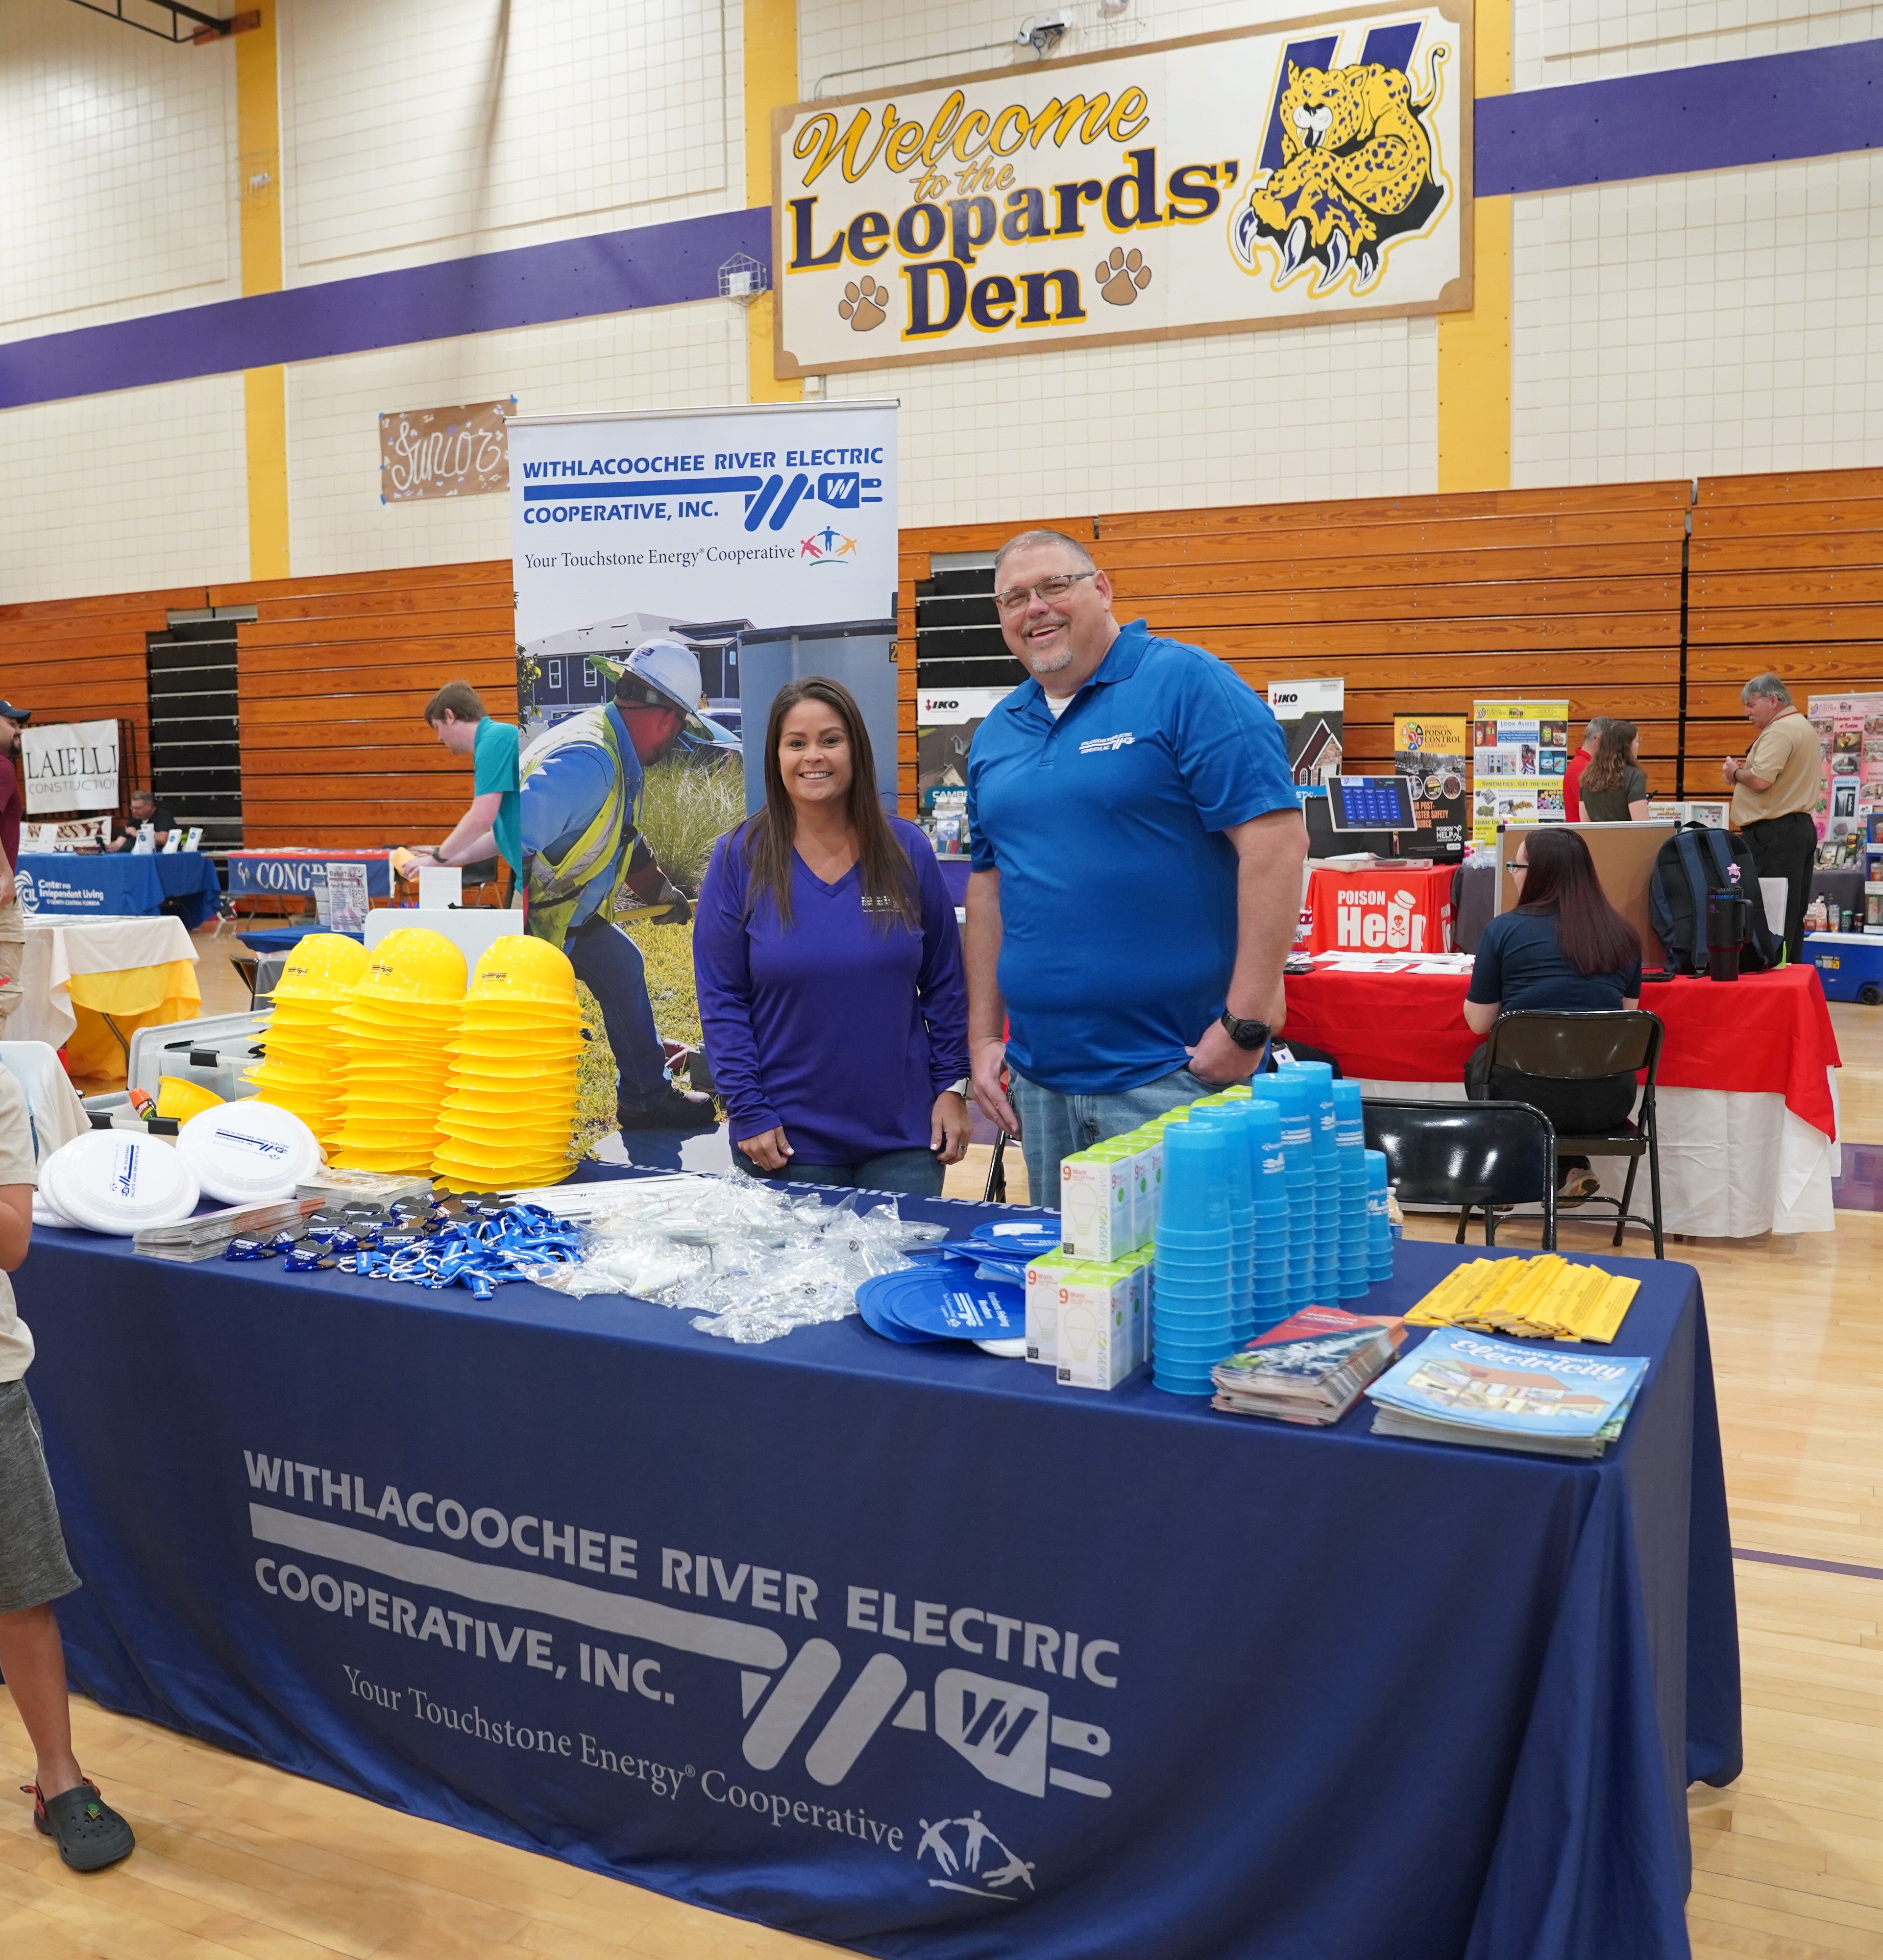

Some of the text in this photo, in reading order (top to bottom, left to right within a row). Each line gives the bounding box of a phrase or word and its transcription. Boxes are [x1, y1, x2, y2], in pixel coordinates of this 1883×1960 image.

[793, 86, 1149, 187] Welcome
[910, 155, 1015, 203] to the
[786, 147, 1240, 274] Leopards'
[899, 260, 1087, 342] Den
[523, 447, 884, 478] WITHLACOOCHEE RIVER ELECTRIC
[523, 500, 718, 524] COOPERATIVE, INC.
[524, 552, 557, 569] Your
[561, 551, 644, 567] Touchstone
[706, 544, 795, 563] Cooperative
[932, 701, 959, 710] IKO
[1278, 694, 1297, 703] IKO
[1421, 801, 1435, 809] POST-
[1431, 810, 1448, 819] SAFETY
[38, 879, 62, 889] Center
[23, 888, 38, 902] CIL
[40, 888, 104, 901] Independent Living
[1338, 890, 1386, 905] POISON
[1063, 1165, 1072, 1180] 9
[1027, 1270, 1036, 1285] 9
[1059, 1288, 1068, 1304] 9
[1449, 1341, 1627, 1381] Electricity
[244, 1449, 1119, 1688] WITHLACOOCHEE RIVER ELECTRIC
[255, 1557, 674, 1705] COOPERATIVE, INC.
[343, 1665, 401, 1712] Your
[408, 1687, 572, 1756] Touchstone
[701, 1770, 904, 1851] Cooperative
